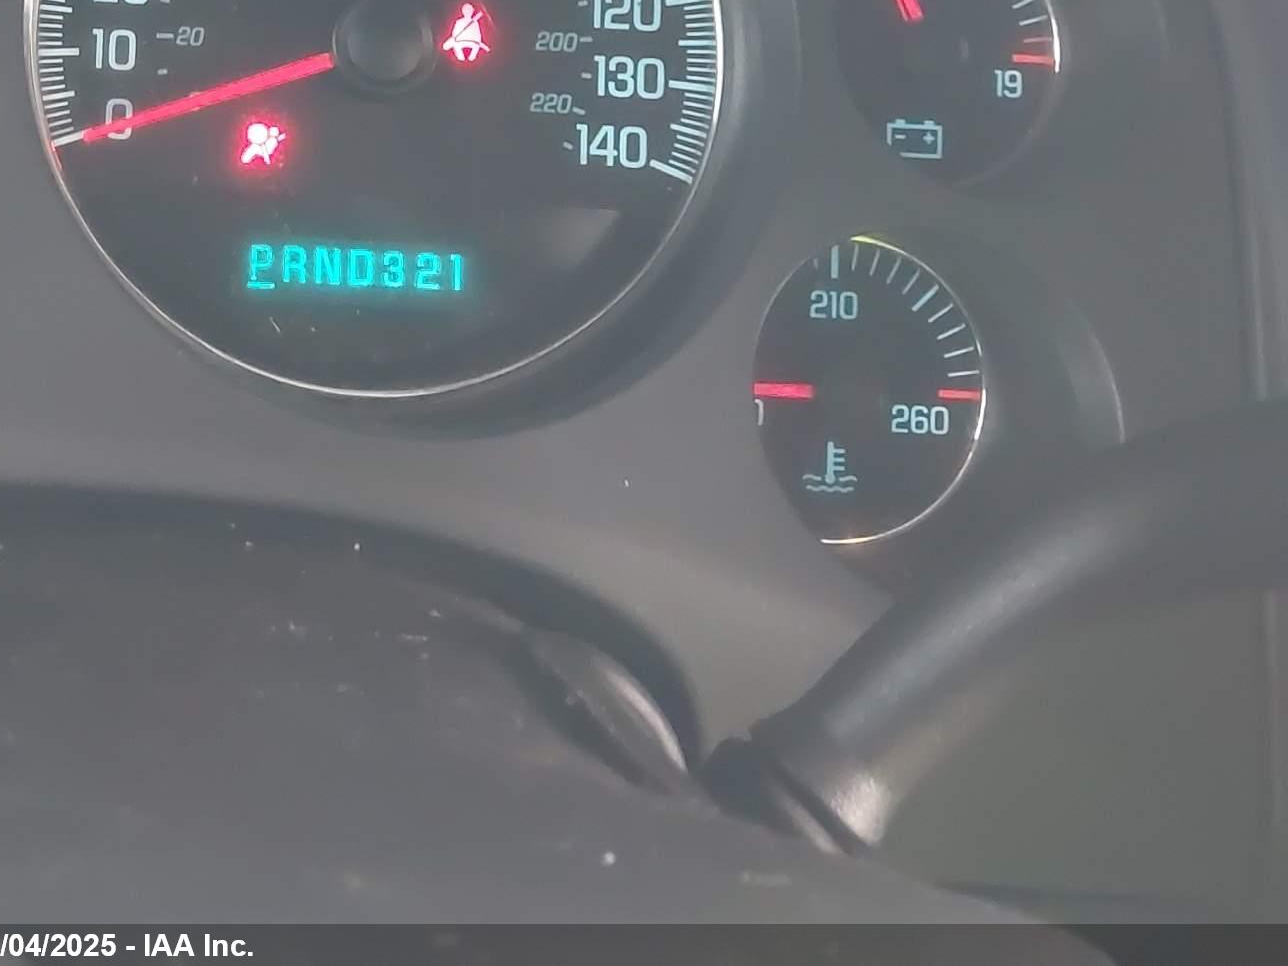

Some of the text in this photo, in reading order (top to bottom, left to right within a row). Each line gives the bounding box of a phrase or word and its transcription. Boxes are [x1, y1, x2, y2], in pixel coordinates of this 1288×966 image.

[92, 29, 136, 71] 10
[175, 26, 205, 47] 20
[535, 32, 577, 53] 200
[594, 56, 665, 99] 130
[994, 69, 1024, 99] 19
[529, 93, 572, 114] 220
[105, 98, 133, 141] 0
[576, 125, 647, 168] 140
[809, 291, 858, 321] 210
[891, 405, 949, 435] 260
